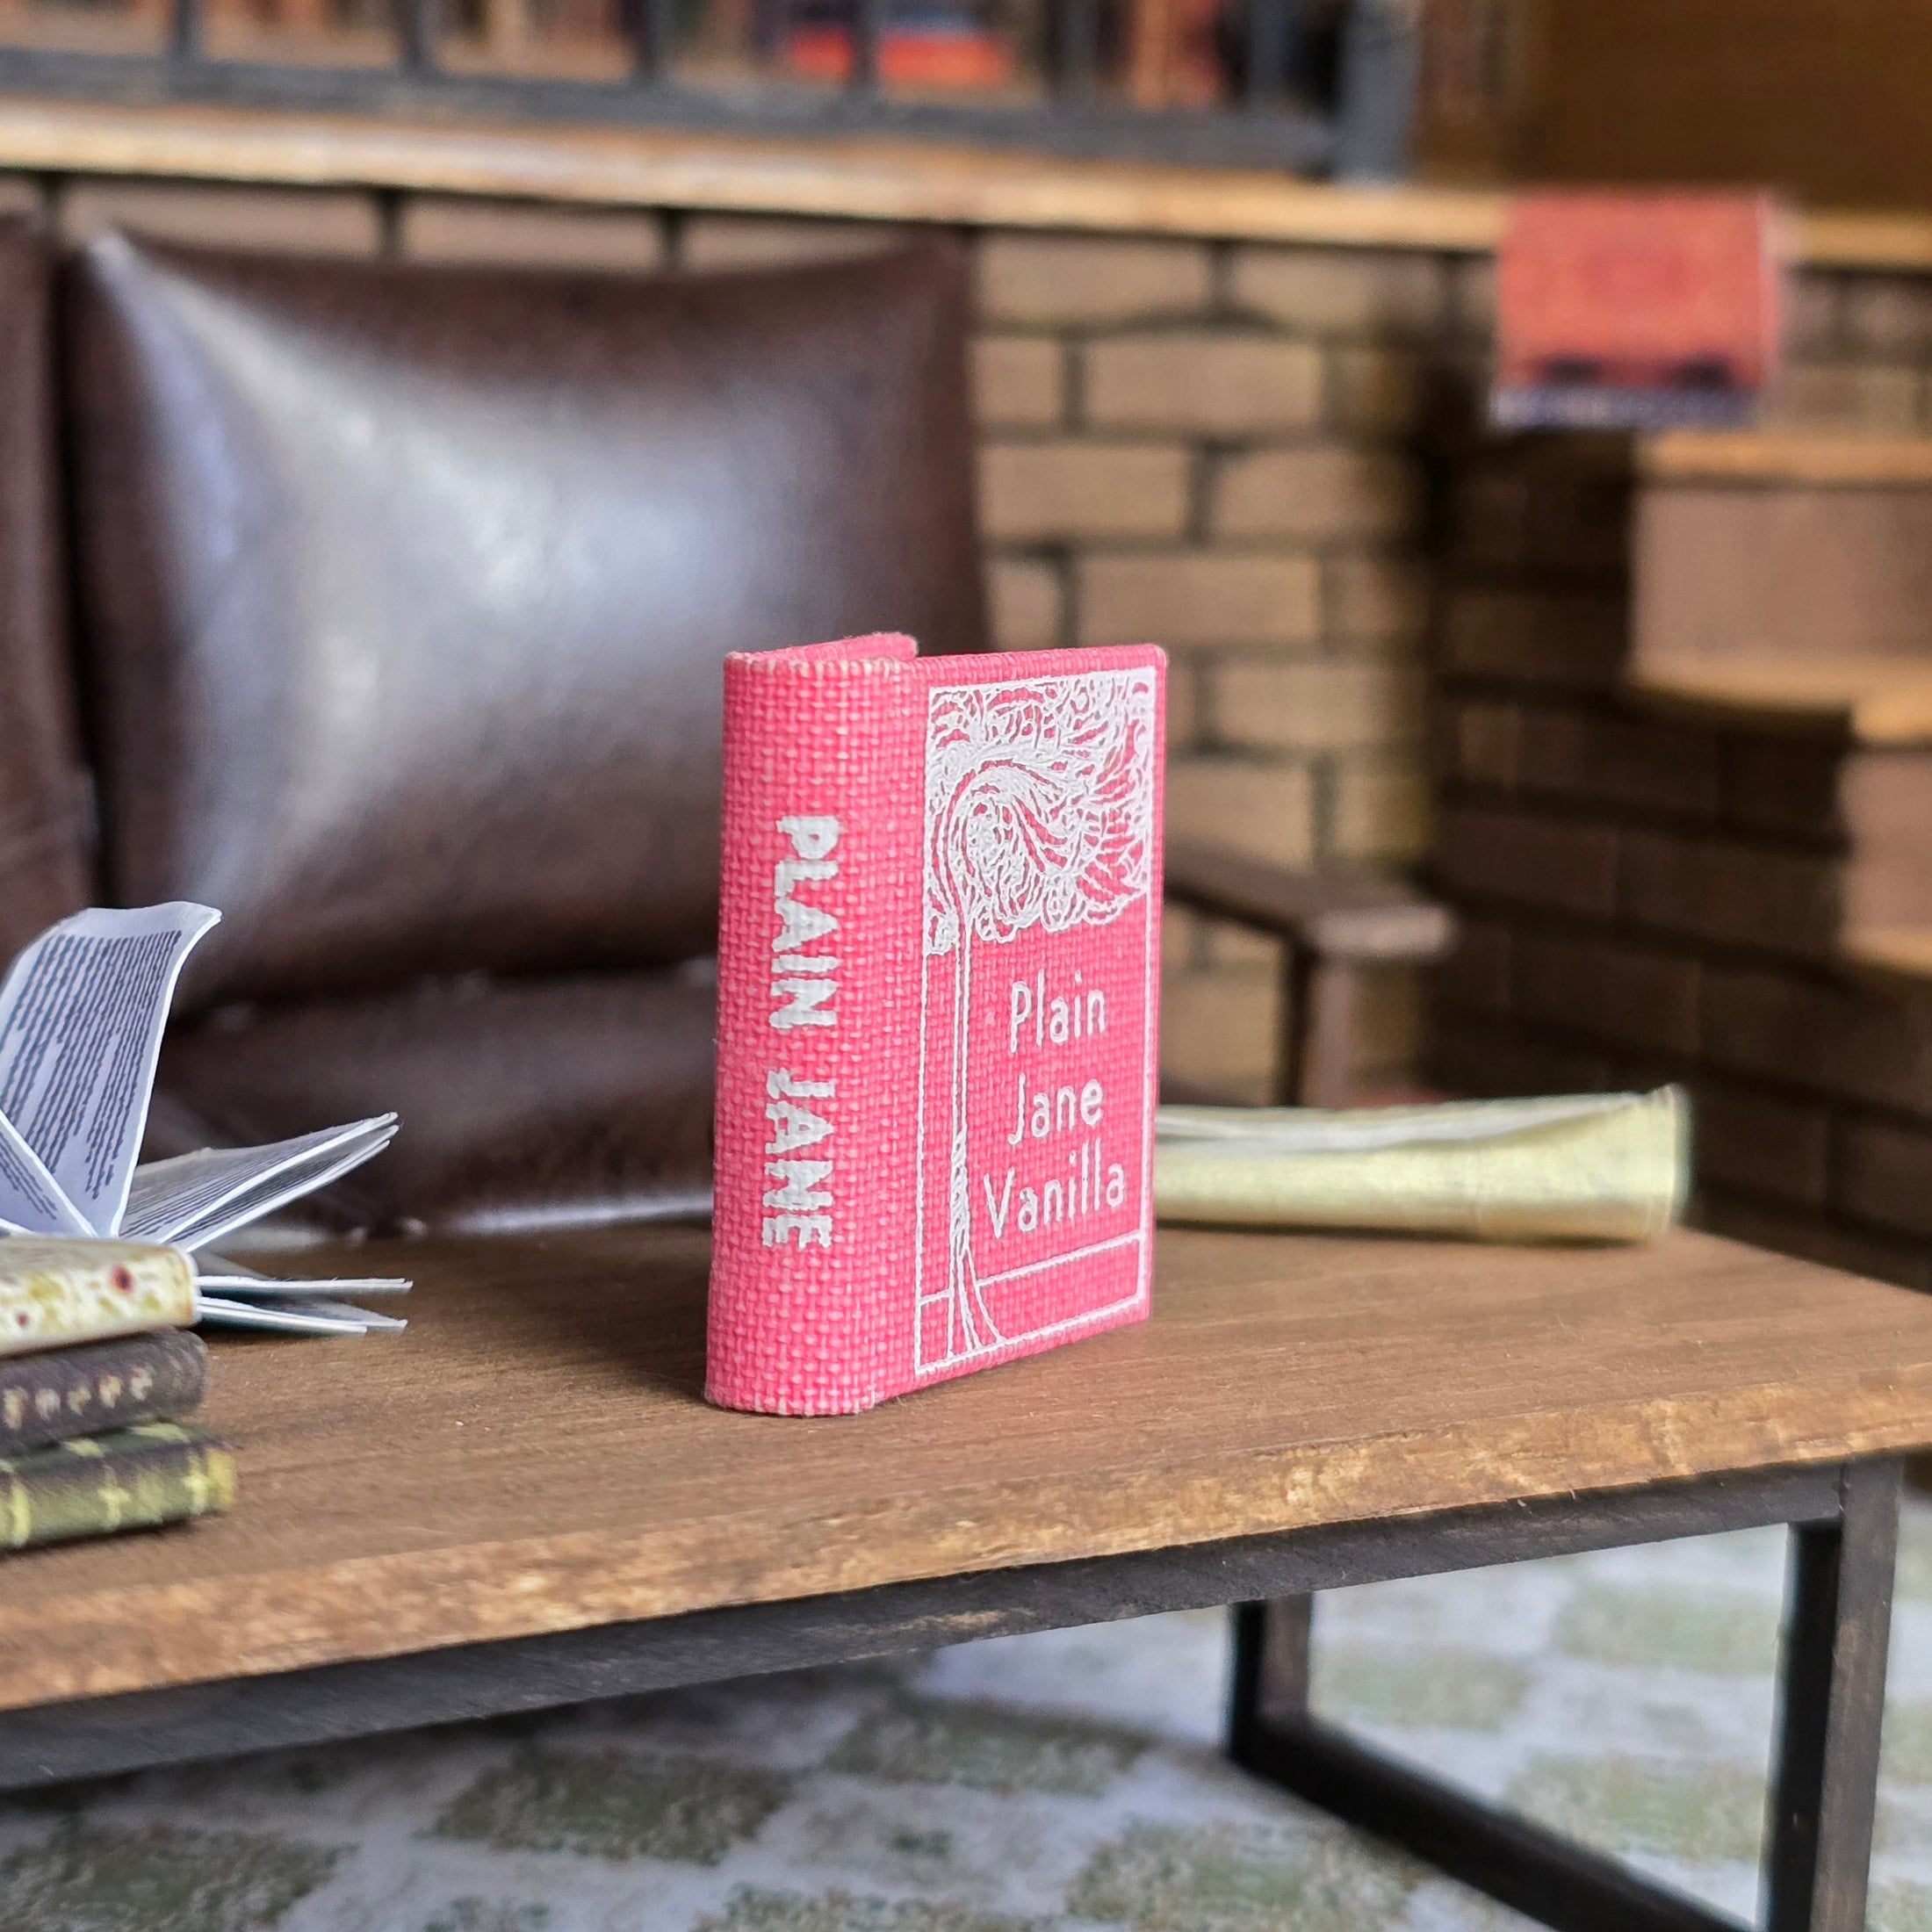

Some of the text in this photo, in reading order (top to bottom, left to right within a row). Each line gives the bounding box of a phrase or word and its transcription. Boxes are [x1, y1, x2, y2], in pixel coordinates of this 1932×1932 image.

[762, 815, 841, 1251] PLAIN JANE
[1010, 969, 1107, 1053] Plain
[1008, 1073, 1105, 1145] Jane
[983, 1138, 1128, 1239] Vanilla
